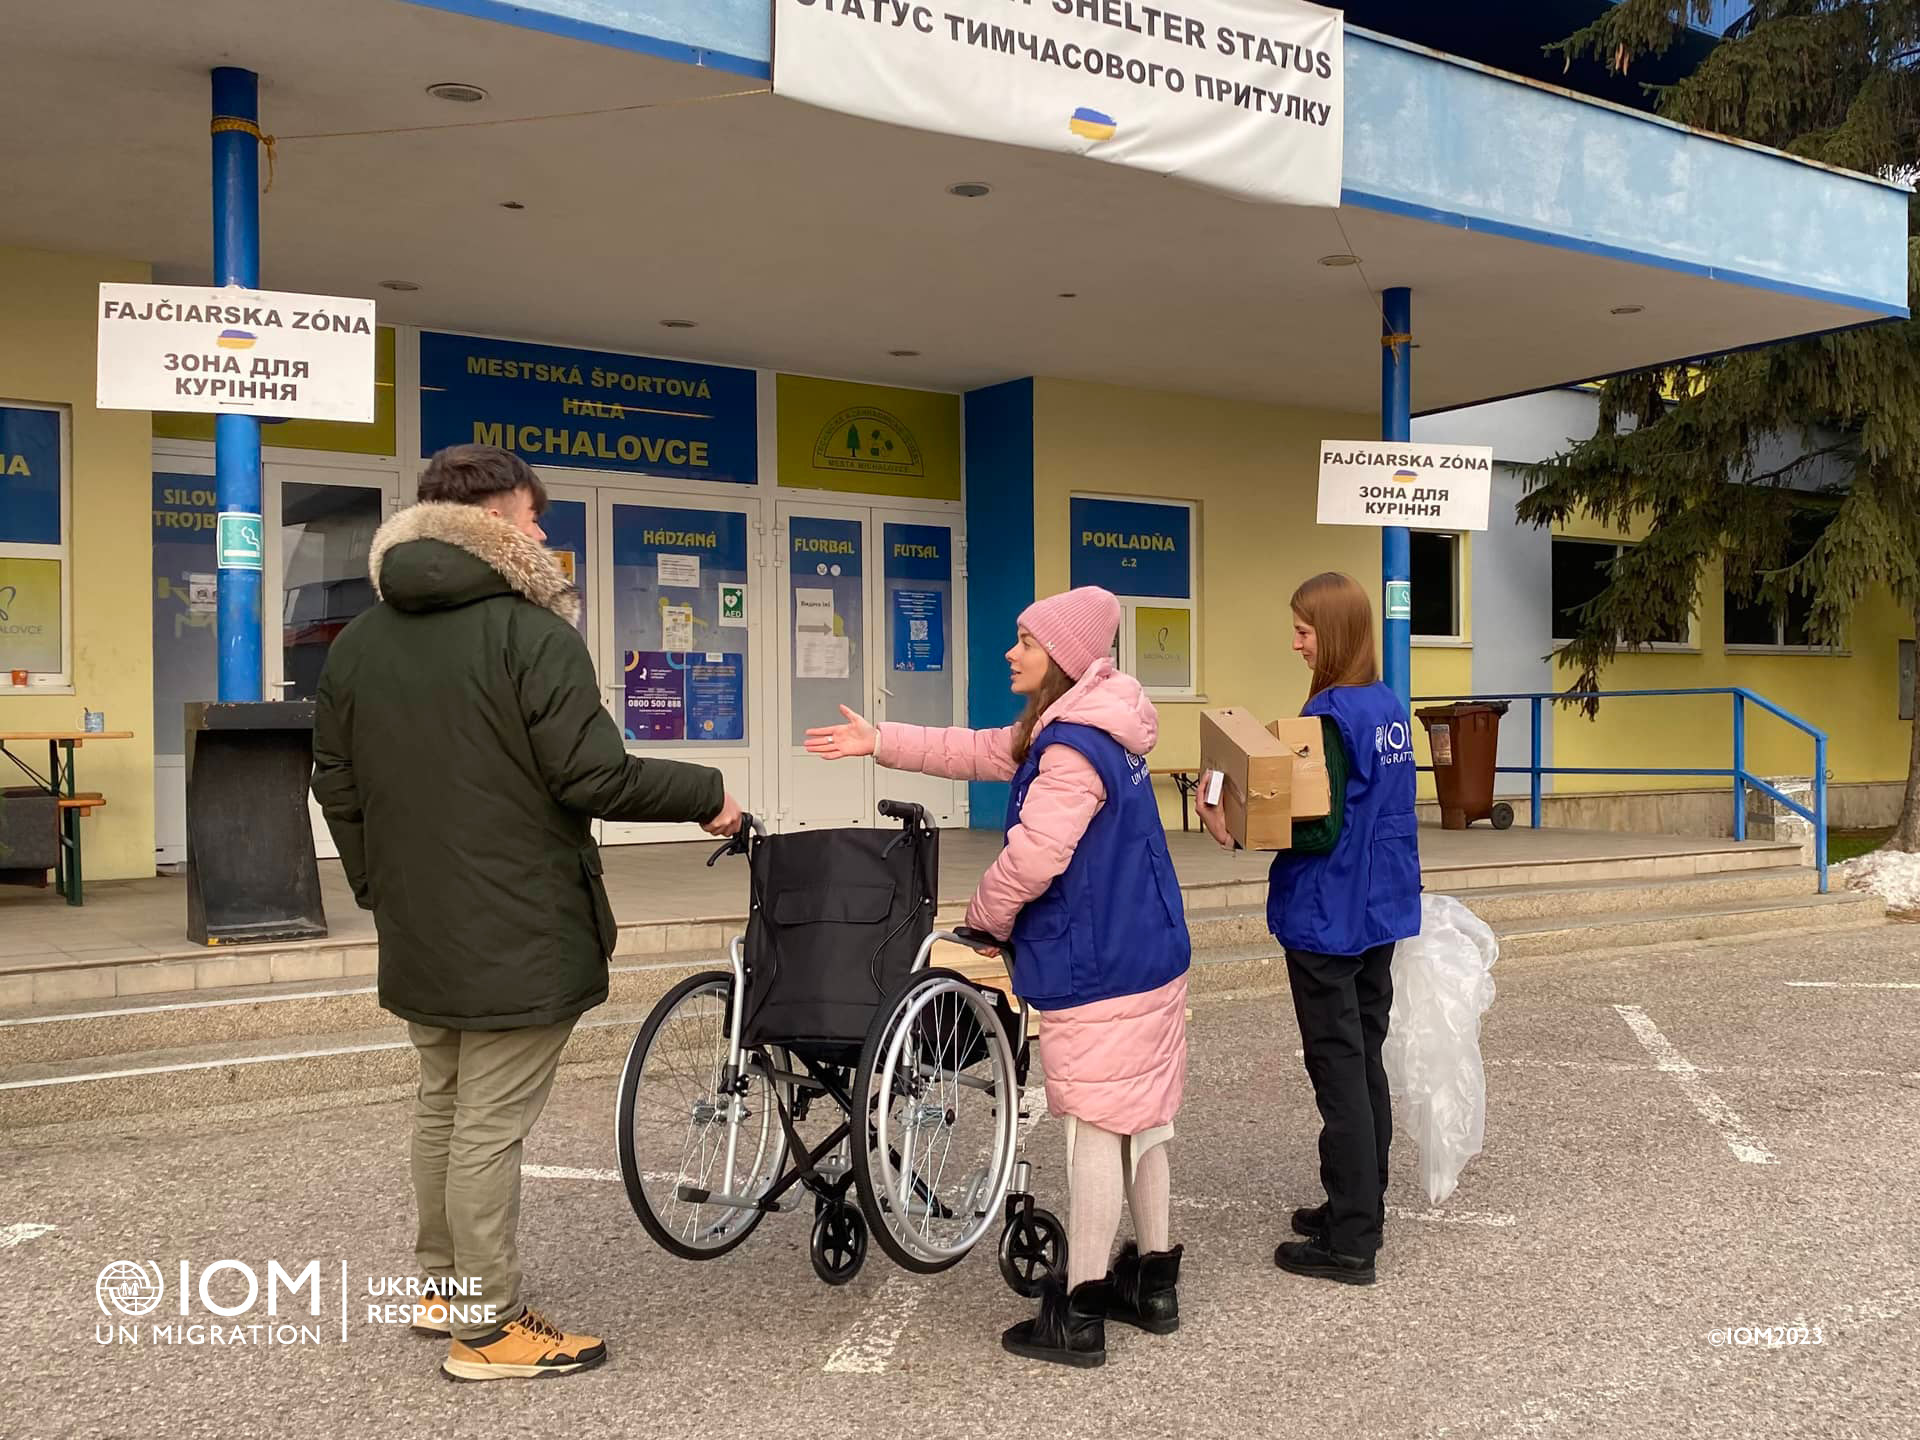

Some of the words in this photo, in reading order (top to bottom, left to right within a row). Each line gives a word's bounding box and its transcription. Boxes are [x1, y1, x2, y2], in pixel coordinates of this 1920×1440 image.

[1053, 0, 1206, 49] SHELTER
[1217, 27, 1332, 79] STATUS
[797, 0, 933, 33] АТУС
[943, 13, 1185, 93] ТИМЧАСОВОГО
[1195, 74, 1331, 126] ПРИТУЛКУ
[104, 299, 283, 328] FAJČIARSKA
[292, 309, 371, 334] ZÓNA
[163, 353, 240, 374] ЗОНА
[249, 358, 310, 379] ДЛЯ
[467, 356, 584, 385] MESTSKÁ
[591, 367, 712, 399] ŠPORTOVÁ
[175, 377, 298, 401] КУРІННЯ
[563, 398, 625, 419] HALA
[473, 422, 709, 467] MICHALOVCE
[1323, 451, 1434, 468] FAJČIARSKA
[1440, 454, 1489, 471] ZÓNA
[1359, 486, 1407, 500] ЗОНА
[1412, 487, 1449, 502] ДЛЯ
[1365, 502, 1441, 517] КУРІННЯ
[643, 528, 717, 548] HÁDZANÁ
[794, 538, 855, 554] FLORBAL
[1082, 531, 1175, 552] POKLADŇA
[893, 544, 940, 559] FUTSAL
[725, 610, 742, 618] AED
